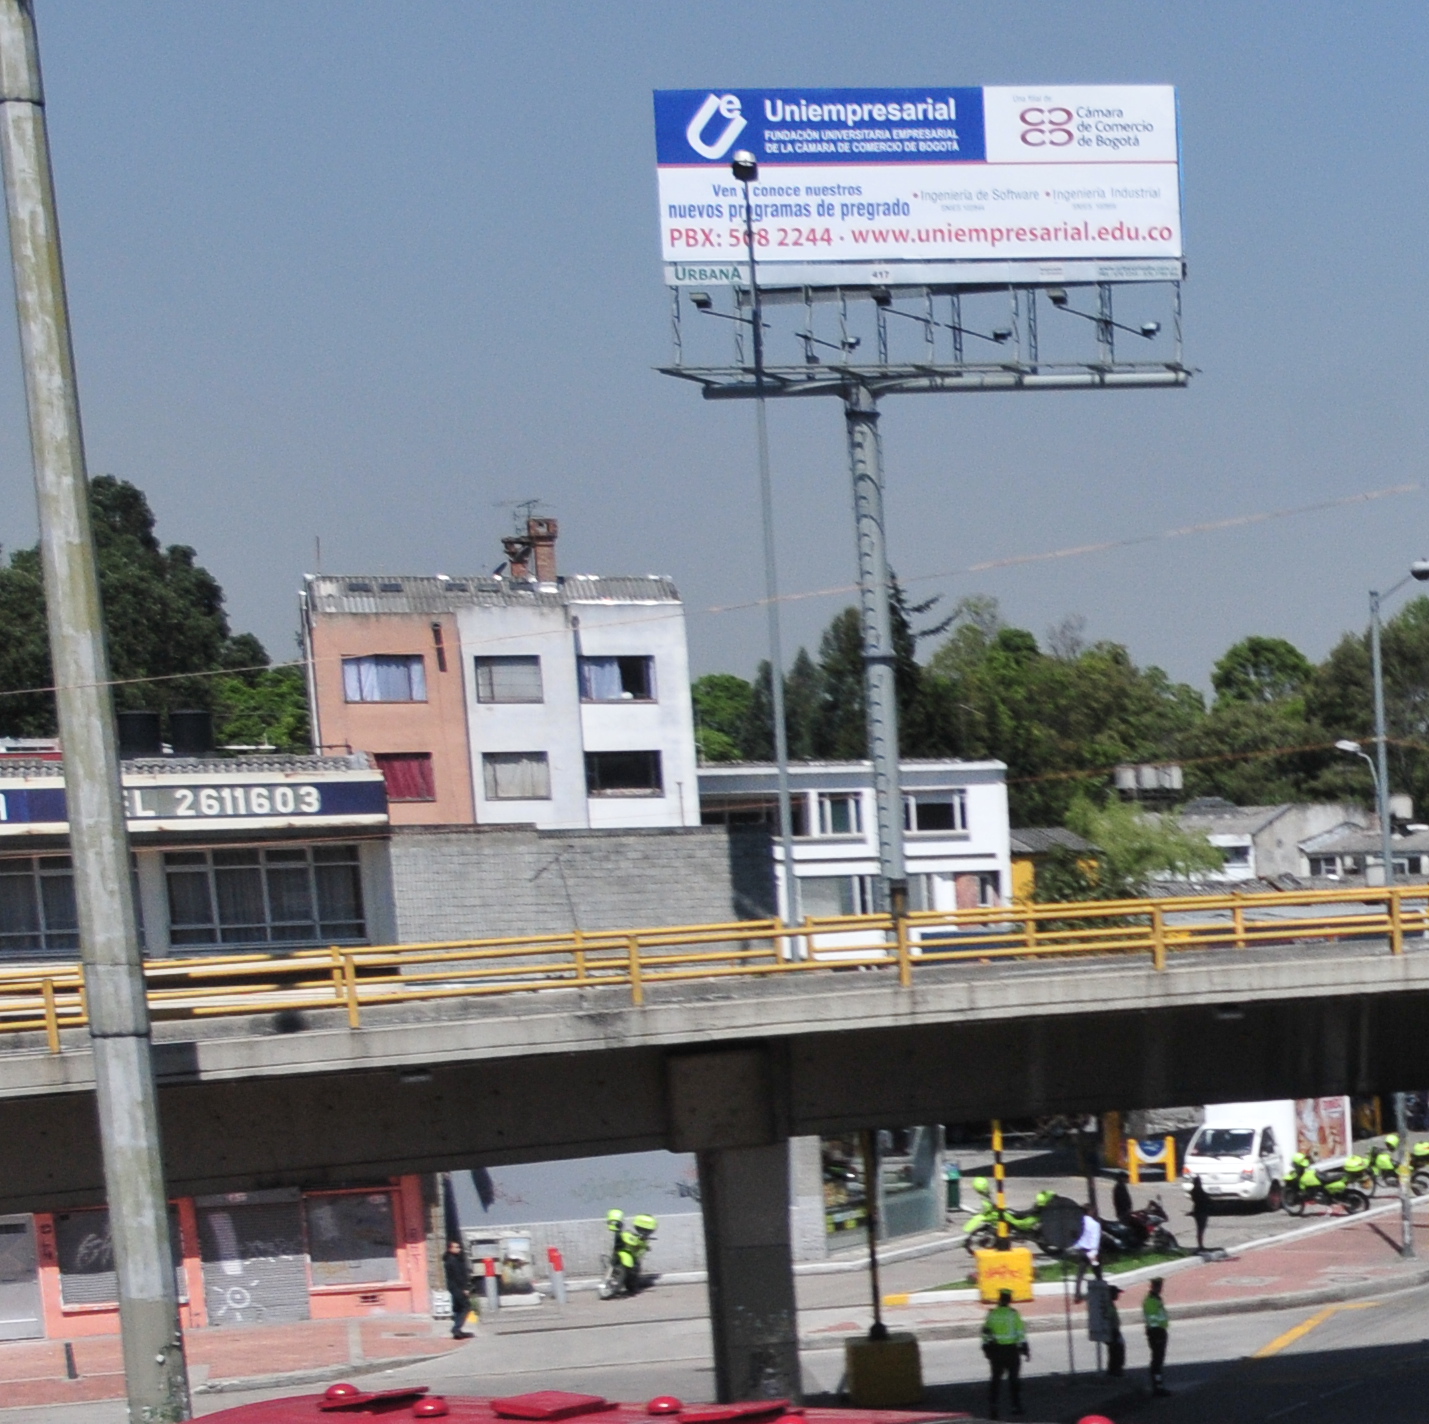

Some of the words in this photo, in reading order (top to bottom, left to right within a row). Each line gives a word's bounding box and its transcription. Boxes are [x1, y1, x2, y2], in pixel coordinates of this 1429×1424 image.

[764, 97, 957, 127] Uniempresarial
[1076, 106, 1123, 118] Cámara
[1077, 121, 1092, 132] de
[1095, 120, 1154, 132] Comercio
[764, 129, 820, 141] FUNDACIÓN
[821, 129, 891, 140] UNIVERSITARIA
[892, 128, 959, 139] EMPRESARIAL
[765, 143, 779, 153] DE
[780, 143, 794, 153] LA
[837, 142, 851, 152] DE
[852, 141, 902, 152] COMERCIO
[904, 141, 918, 152] DE
[1077, 135, 1092, 147] de
[1096, 135, 1140, 150] Bogotá
[713, 184, 737, 197] Ven
[752, 185, 801, 197] conoce
[805, 184, 862, 196] nuestros
[977, 189, 989, 200] de
[992, 189, 1039, 200] Software
[1111, 187, 1161, 199] Industrial
[668, 203, 723, 218] nuevos
[817, 198, 835, 217] de
[841, 198, 910, 221] pregrado
[669, 228, 722, 248] PBX:
[729, 228, 770, 247] 508
[777, 227, 833, 247] 2244
[851, 220, 1173, 246] www.uniempresarial.edu.co
[674, 266, 742, 281] URBANA
[174, 786, 322, 816] 2611603
